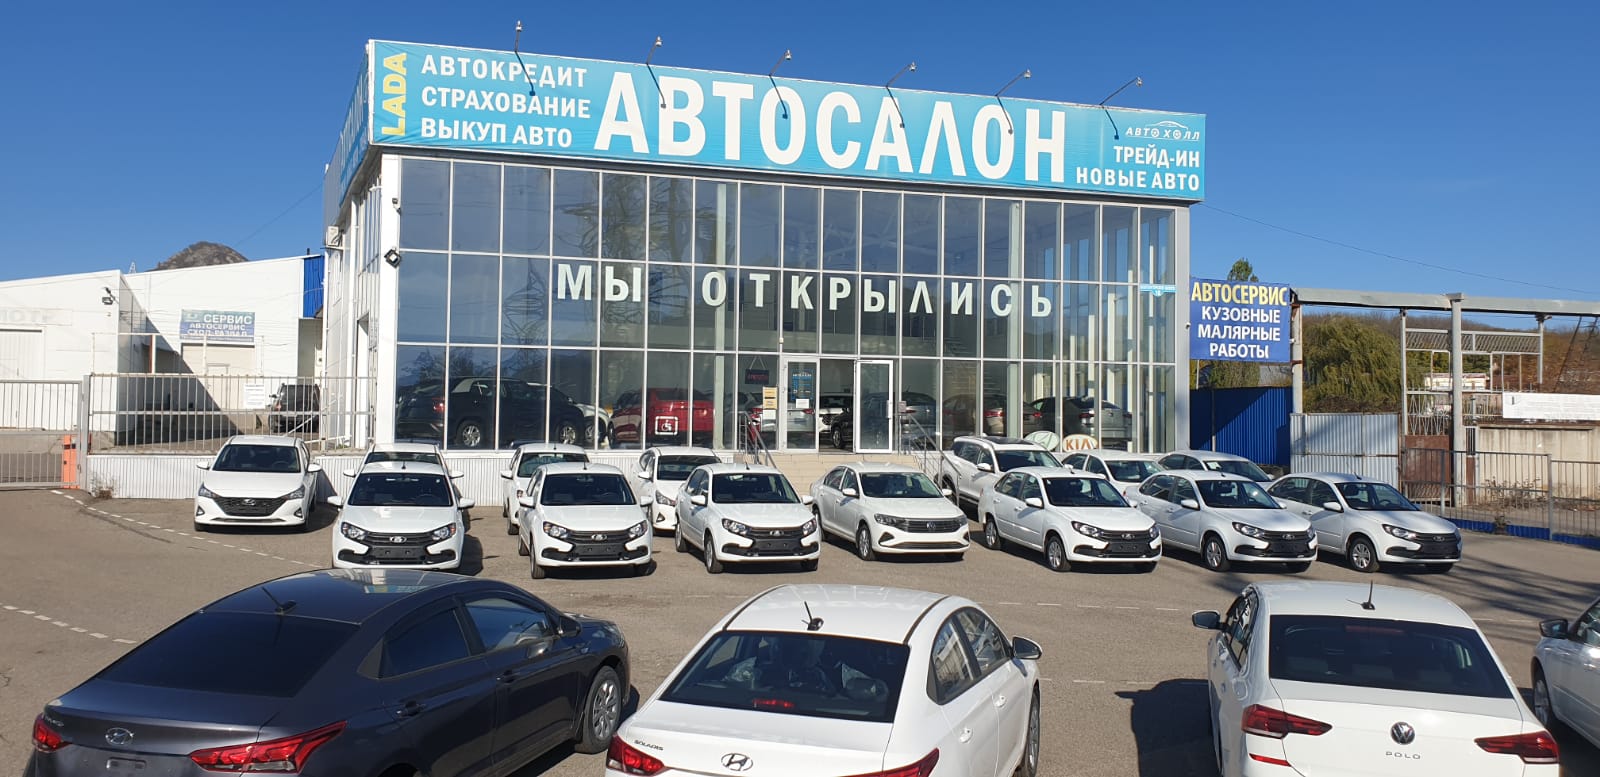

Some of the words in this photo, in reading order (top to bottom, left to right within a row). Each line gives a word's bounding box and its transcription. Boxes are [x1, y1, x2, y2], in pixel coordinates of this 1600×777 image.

[421, 54, 587, 88] АВТОКРЕДИТ
[381, 53, 408, 136] LADA
[421, 86, 591, 119] СТРАХОВАНИЕ
[421, 117, 506, 143] ВЫКУП
[512, 125, 572, 148] АВТО
[593, 71, 1066, 183] АВТОСАЛОН
[1125, 127, 1160, 138] АВТО
[1163, 129, 1200, 140] ХОЛЛ
[1113, 143, 1200, 169] ТРЕЙД-ИН
[1076, 166, 1147, 188] НОВЫЕ
[1151, 172, 1200, 191] АВТО
[557, 263, 641, 302] МЫ
[701, 271, 1052, 318] ОТКРЫЛИСЬ
[1191, 281, 1288, 306] АВТОСЕРВИС
[189, 322, 246, 331] АВТОСЕРВИС
[203, 314, 253, 325] СЕРВИС
[1201, 306, 1281, 323] КУЗОВНЫЕ
[1198, 323, 1281, 341] МАЛЯРНЫЕ
[1209, 342, 1270, 359] РАБОТЫ
[1066, 438, 1092, 450] KIA
[1385, 751, 1421, 759] POLO
